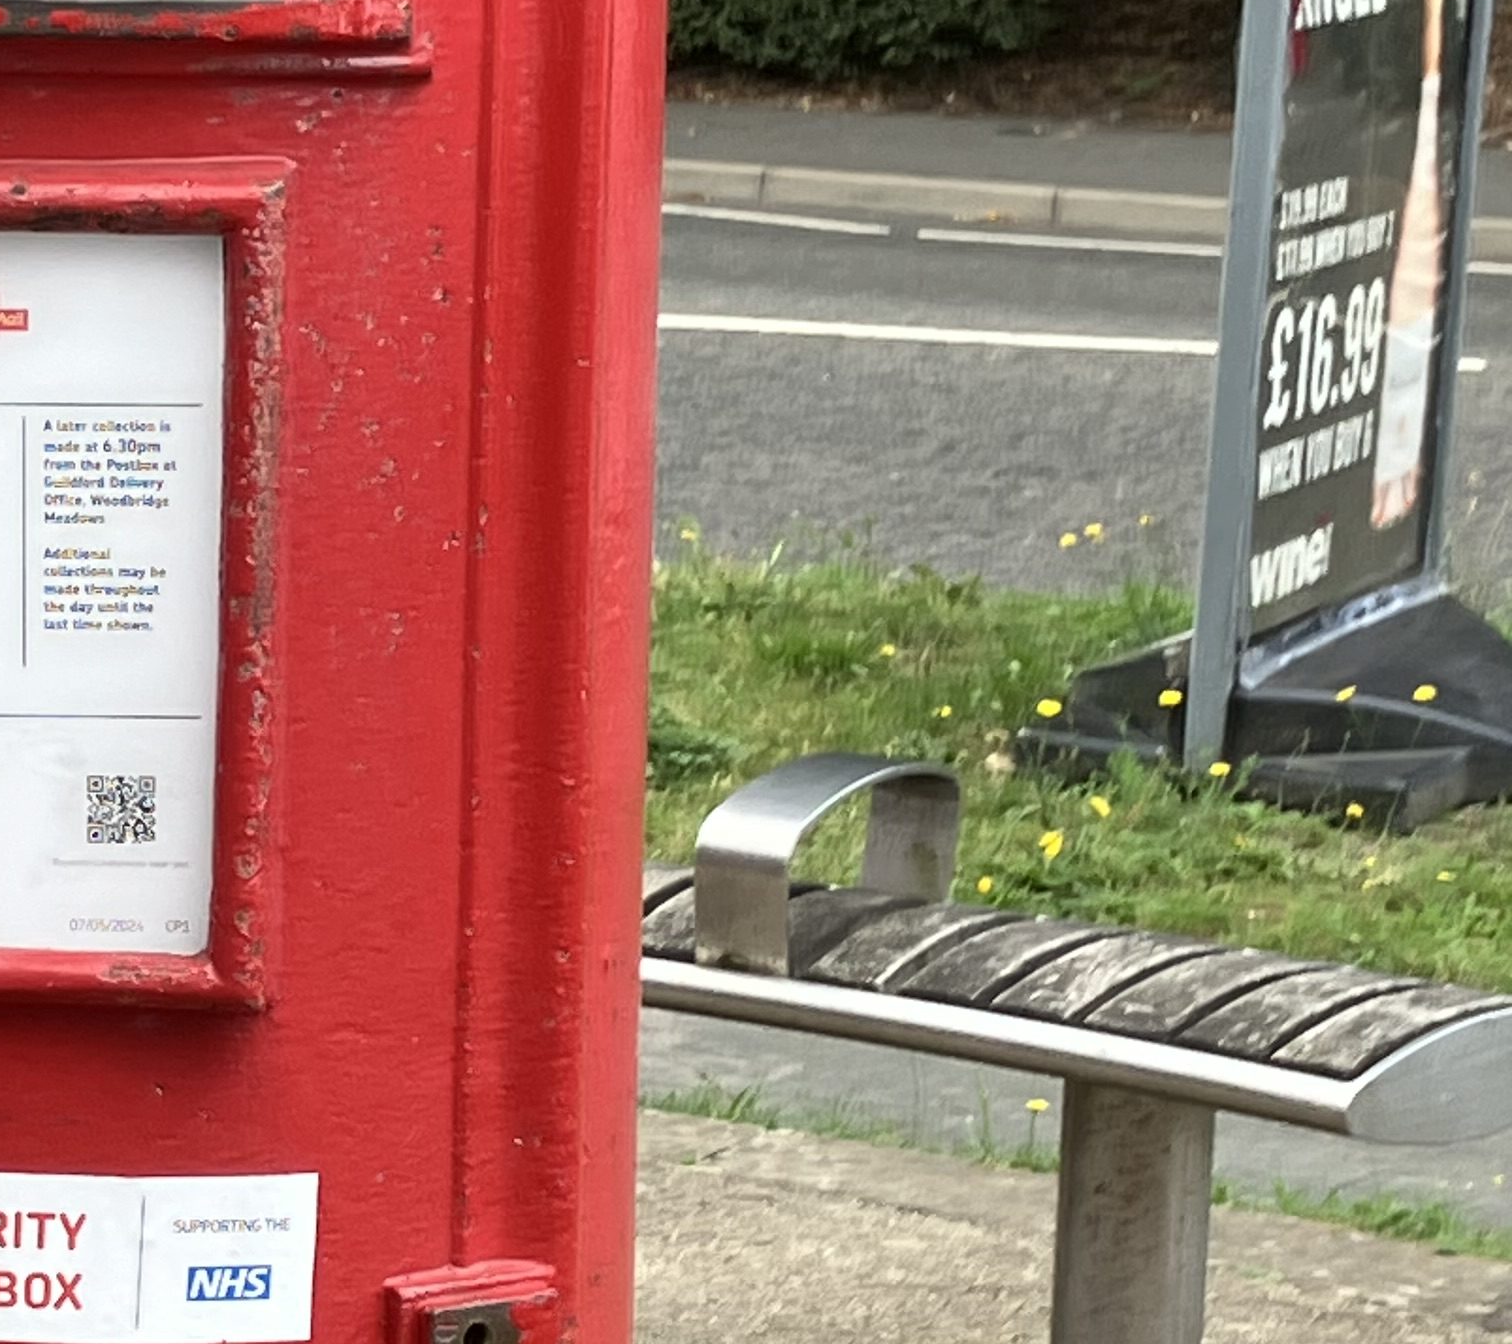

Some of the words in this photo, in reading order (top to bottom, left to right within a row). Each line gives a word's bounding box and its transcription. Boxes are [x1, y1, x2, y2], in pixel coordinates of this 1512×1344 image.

[1263, 277, 1386, 431] £16.99
[43, 419, 53, 432] A
[56, 419, 87, 432] later
[92, 419, 156, 432] collection
[159, 419, 172, 432] is
[43, 440, 80, 453] made
[85, 441, 99, 453] at
[103, 438, 162, 456] 6.30pm
[43, 458, 76, 471] from
[80, 458, 102, 471] the
[106, 458, 159, 471] Postbox
[163, 460, 177, 472] at
[1257, 435, 1305, 501] WHEN
[1305, 425, 1336, 484] YOU
[1333, 415, 1365, 471] BUY
[43, 476, 105, 489] Guildford
[109, 476, 165, 492] Delivery
[90, 494, 170, 510] Woodbridge
[43, 512, 106, 525] Meadows
[43, 547, 112, 560] Additional
[43, 565, 114, 578] collections
[118, 567, 146, 581] may
[150, 566, 167, 578] be
[43, 584, 81, 596] made
[85, 584, 161, 598] throughout
[43, 601, 65, 613] the
[69, 601, 94, 615] day
[97, 601, 129, 613] until
[133, 601, 154, 613] the
[43, 619, 69, 630] last
[73, 619, 103, 631] time
[107, 619, 154, 632] shown.
[172, 1217, 263, 1234] SUPPORTING
[265, 1217, 292, 1232] THE
[189, 1267, 269, 1299] NHS
